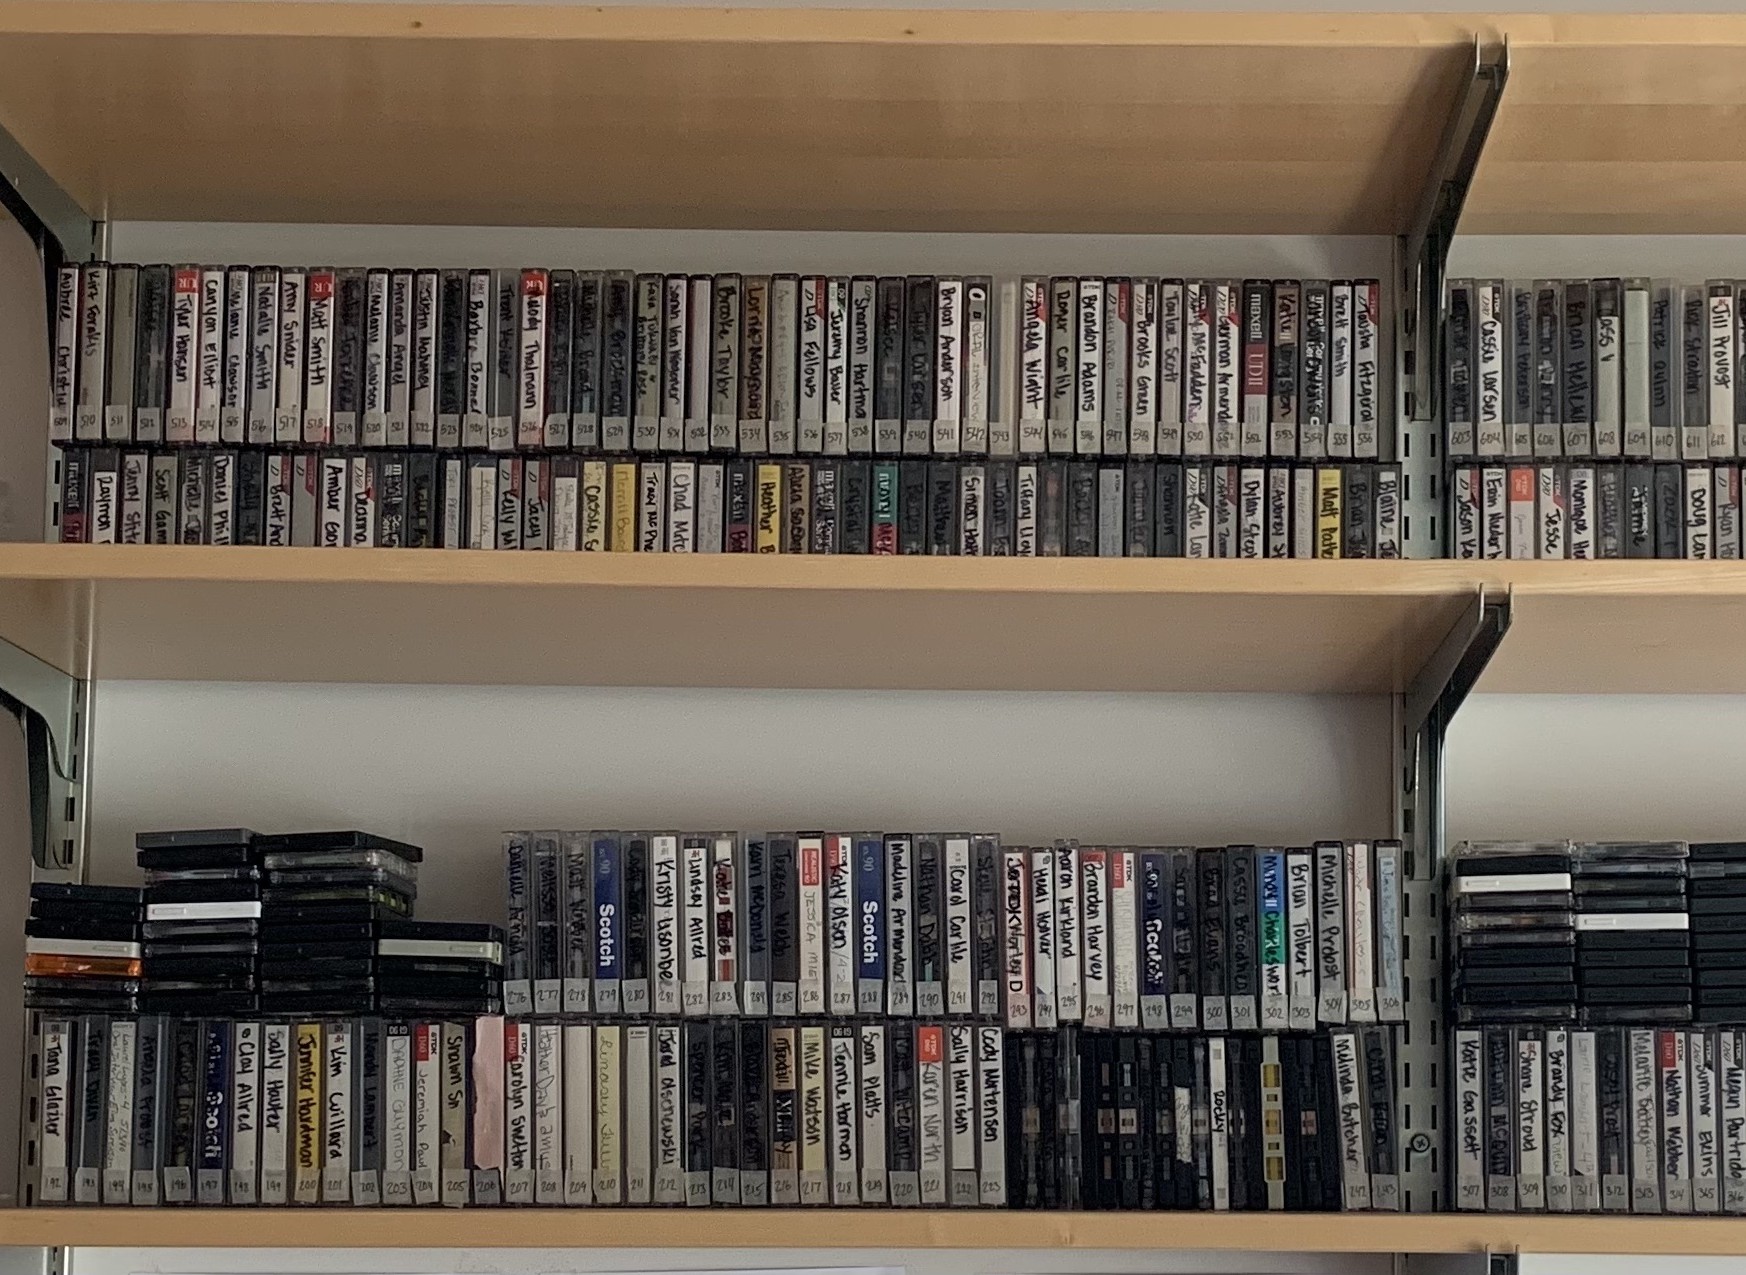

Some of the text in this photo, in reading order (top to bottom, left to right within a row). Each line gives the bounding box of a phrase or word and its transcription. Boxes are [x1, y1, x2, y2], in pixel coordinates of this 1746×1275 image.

[394, 283, 407, 336] Amanda
[418, 288, 431, 330] Justin
[855, 297, 869, 354] Shannon
[1250, 294, 1262, 339] maxell
[175, 295, 195, 382] Tyler Hansen
[198, 279, 218, 389] Canyon Elliott
[286, 321, 298, 368] Snider
[310, 299, 328, 386] Matt Smith
[669, 326, 682, 347] Van
[716, 286, 736, 399] Brooke Taylor
[940, 287, 956, 401] Bryan Anderson
[1137, 321, 1151, 368] Brooks
[1713, 305, 1730, 388] Jill Provost
[256, 344, 270, 390] Smith
[804, 342, 820, 398] Fellows
[1082, 295, 1097, 411] Brandon Adams
[1166, 348, 1178, 382] Scott
[1335, 337, 1347, 377] Smith
[1483, 371, 1499, 421] Larsen
[278, 416, 296, 430] 517
[491, 427, 509, 439] 525
[549, 424, 565, 435] 527
[577, 425, 593, 434] 528
[637, 426, 655, 437] 530
[741, 428, 760, 440] 534
[879, 428, 896, 441] 539
[937, 428, 954, 441] 541
[966, 426, 985, 442] 542
[1451, 434, 1470, 445] 603
[1567, 434, 1588, 447] 607
[1599, 432, 1615, 445] 608
[156, 469, 170, 503] Scott
[214, 457, 229, 503] Daniel
[327, 465, 342, 511] Amber
[646, 473, 661, 506] Tracy
[673, 474, 691, 511] Chad
[1015, 474, 1033, 519] Tiffany
[1245, 481, 1260, 516] Dylan
[271, 485, 284, 522] Brett
[585, 486, 600, 533] Cassie
[761, 483, 775, 533] Heather
[964, 478, 979, 521] Simon
[1321, 488, 1338, 518] Matt
[1379, 481, 1395, 527] Blaine
[1687, 489, 1707, 526] Doug
[1545, 509, 1562, 553] Jesse
[1717, 503, 1735, 537] Ryan
[600, 860, 610, 874] 90
[863, 858, 873, 871] 90
[654, 860, 675, 908] Kristy
[1033, 868, 1048, 903] Heidi
[1321, 855, 1338, 919] Michelle
[830, 864, 848, 948] Katy Olson
[950, 869, 967, 963] Carol Carlile
[1058, 848, 1073, 958] Aaron Kirkland
[1085, 862, 1106, 980] Brandon Harvey
[1292, 864, 1312, 977] Brian Tolbert
[600, 904, 615, 966] Scotch
[692, 918, 706, 960] Allred
[863, 901, 878, 963] Scotch
[537, 988, 558, 1001] 277
[599, 990, 616, 1001] 279
[685, 993, 703, 1006] 282
[715, 991, 732, 1002] 283
[776, 992, 793, 1004] 285
[834, 992, 851, 1004] 287
[861, 991, 877, 1003] 288
[920, 992, 939, 1007] 290
[950, 991, 965, 1005] 291
[1010, 981, 1023, 992] D
[1352, 999, 1370, 1010] 305
[1010, 1003, 1027, 1017] 293
[1233, 1008, 1250, 1018] 301
[1265, 1008, 1282, 1019] 302
[1292, 1007, 1310, 1018] 303
[264, 1031, 285, 1069] Sally
[448, 1036, 462, 1085] Shawn
[980, 1029, 999, 1061] Cody
[1461, 1041, 1479, 1082] Katie
[1693, 1043, 1702, 1063] D60
[1722, 1040, 1732, 1061] D60
[237, 1043, 255, 1132] Clay Allred
[863, 1032, 882, 1118] Sam Platts
[950, 1027, 973, 1134] Sally Harrison
[1665, 1069, 1682, 1117] Nathan
[299, 1034, 316, 1168] Jennifer Hardman
[329, 1046, 346, 1159] Kim Willard
[804, 1043, 822, 1145] Mike Watson
[835, 1042, 853, 1160] Jennie Harmon
[1212, 1091, 1226, 1132] Rocky
[1336, 1039, 1360, 1164] Melinda Butcher
[1518, 1051, 1538, 1152] Shane Stroud
[1548, 1051, 1565, 1137] Brandy Fox
[417, 1070, 429, 1168] Jeremiah Paul
[924, 1115, 942, 1163] North
[387, 1182, 407, 1195] 203
[447, 1181, 467, 1191] 205
[569, 1182, 587, 1194] 209
[599, 1178, 615, 1191] 210
[802, 1182, 821, 1195] 217
[836, 1182, 851, 1193] 218
[893, 1184, 912, 1196] 220
[1491, 1186, 1508, 1197] 308
[1522, 1183, 1539, 1196] 309
[1576, 1183, 1592, 1196] 311
